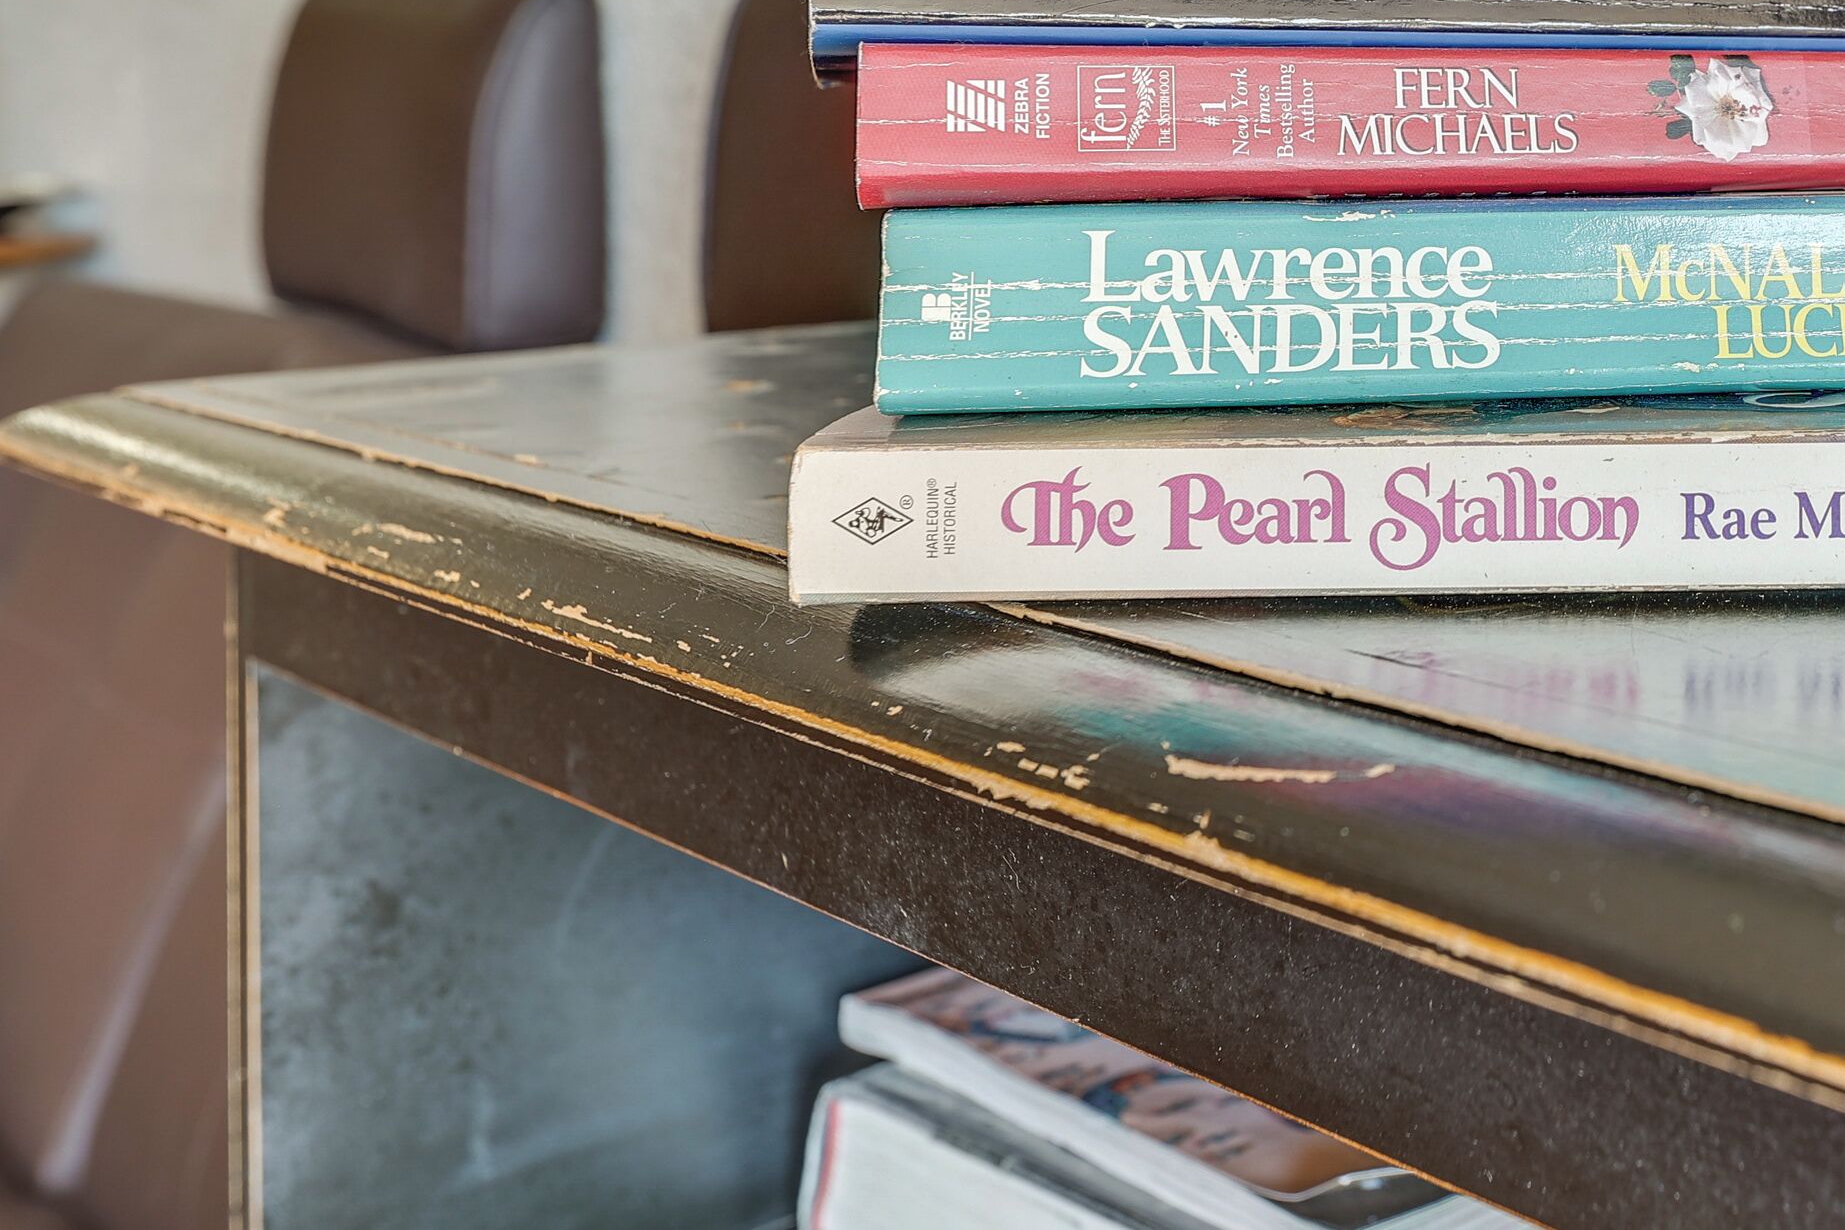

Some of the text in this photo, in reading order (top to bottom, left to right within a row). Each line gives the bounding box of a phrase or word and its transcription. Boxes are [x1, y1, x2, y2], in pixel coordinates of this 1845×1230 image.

[1014, 78, 1029, 134] ZEBRA
[1035, 73, 1050, 139] FICTION
[1080, 72, 1127, 144] fern
[1157, 69, 1171, 146] THE SISTERHOOD
[1199, 100, 1227, 127] #1
[1230, 67, 1250, 156] New York
[1253, 84, 1272, 139] Times
[1275, 64, 1296, 159] Bestselling
[1297, 78, 1316, 144] Author
[1393, 67, 1519, 110] FERN
[1336, 113, 1580, 156] MICHAELS
[1080, 230, 1493, 304] Lawrence
[949, 272, 968, 341] BERKLEY
[973, 279, 991, 333] NOVEL
[1080, 300, 1501, 378] SANDERS
[943, 482, 957, 555] HISTORICAL
[1001, 463, 1641, 570] The Pearl Stallion
[1680, 492, 1777, 541] Rae
